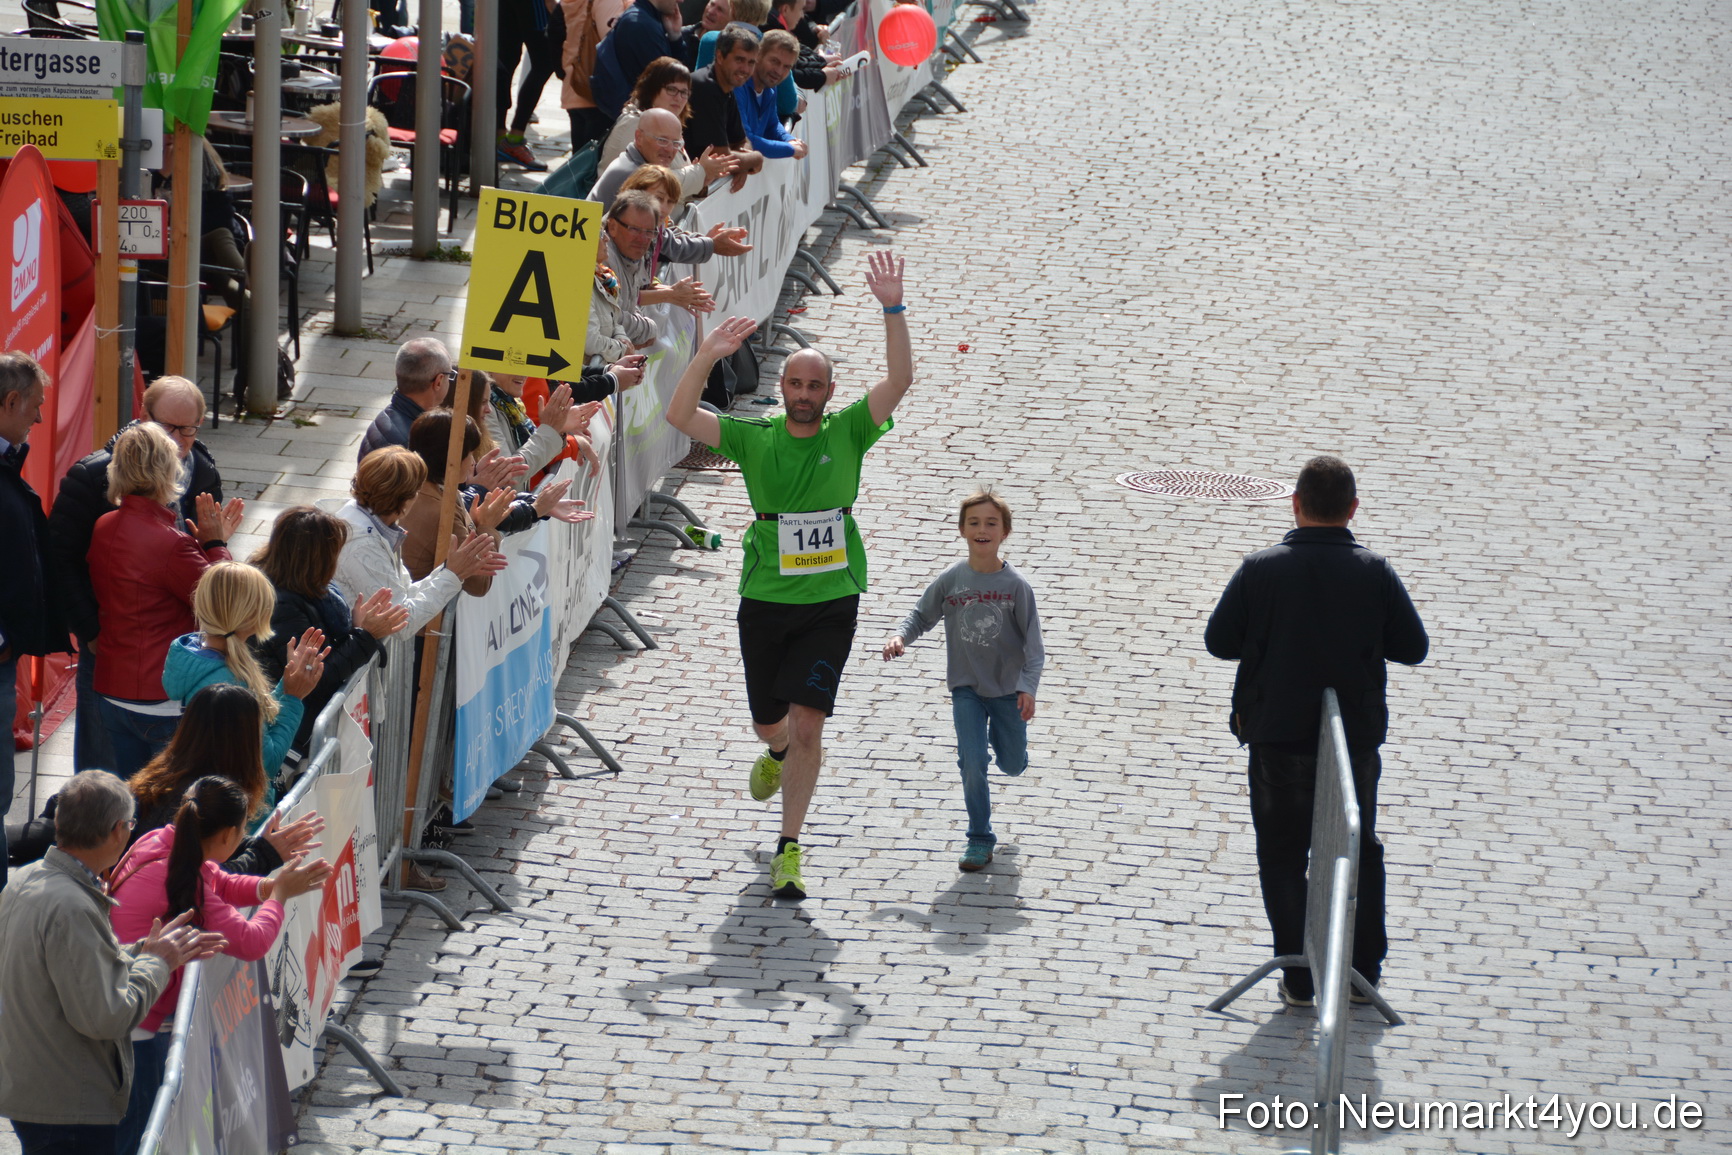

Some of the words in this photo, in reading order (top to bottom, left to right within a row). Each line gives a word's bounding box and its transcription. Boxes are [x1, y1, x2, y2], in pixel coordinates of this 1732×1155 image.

[0, 46, 101, 80] tergasse
[2, 109, 63, 126] uschen
[121, 206, 148, 220] 200
[493, 197, 589, 241] Block
[489, 249, 560, 341] A
[803, 516, 835, 526] Neumarkt
[793, 525, 834, 551] 144
[795, 555, 833, 567] Christian
